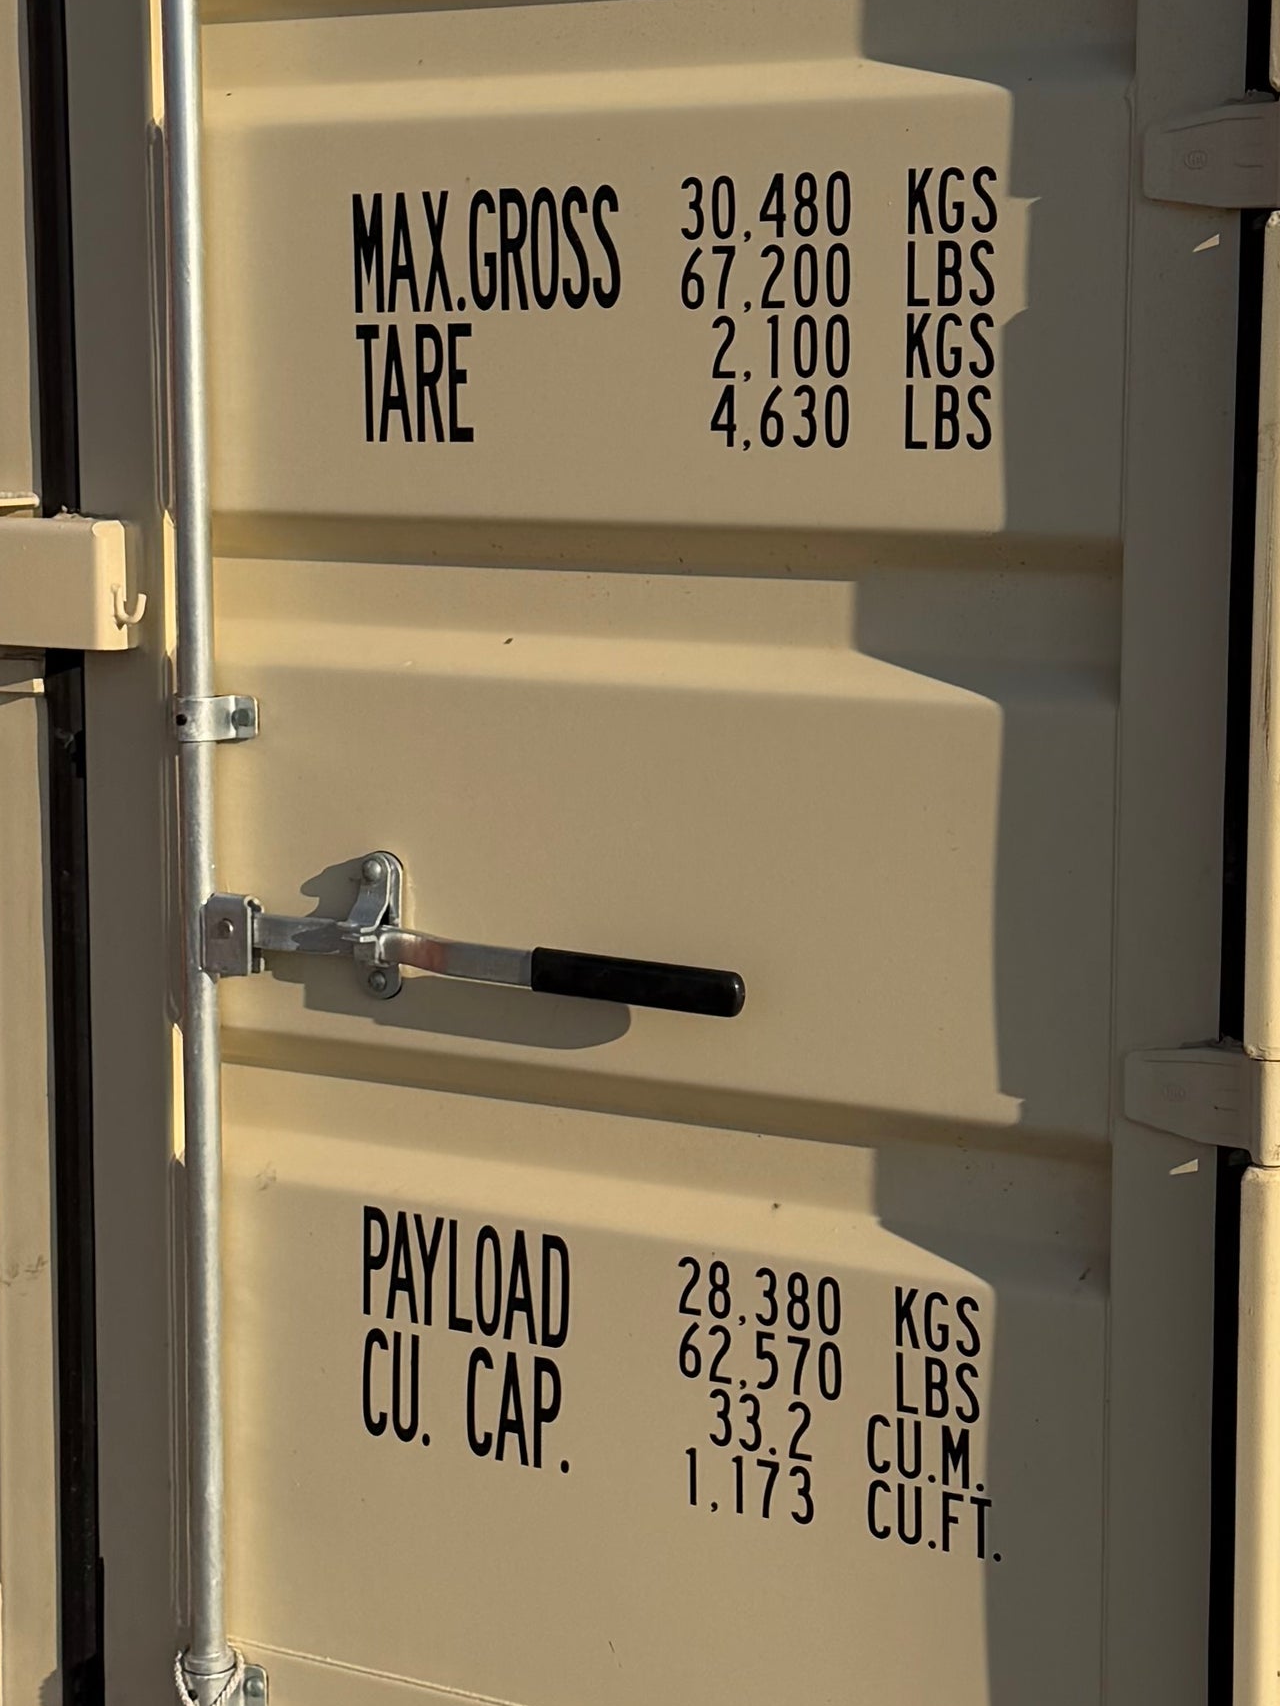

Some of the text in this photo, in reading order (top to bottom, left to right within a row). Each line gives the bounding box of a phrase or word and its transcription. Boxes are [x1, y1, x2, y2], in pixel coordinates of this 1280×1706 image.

[351, 165, 999, 314] MAX.GROSS 30,480 KGS
[680, 238, 996, 314] 67,200 LBS
[355, 311, 996, 443] TARE 2,100 KGS
[709, 383, 993, 452] 4,630 LBS
[362, 1204, 982, 1358] PAYLOAD 28,380 KGS
[361, 1327, 986, 1493] CU. CAP. 33.2 CU.M.
[678, 1321, 981, 1425] 62,570 LBS
[684, 1446, 1003, 1563] 1,173 CU.FT.
